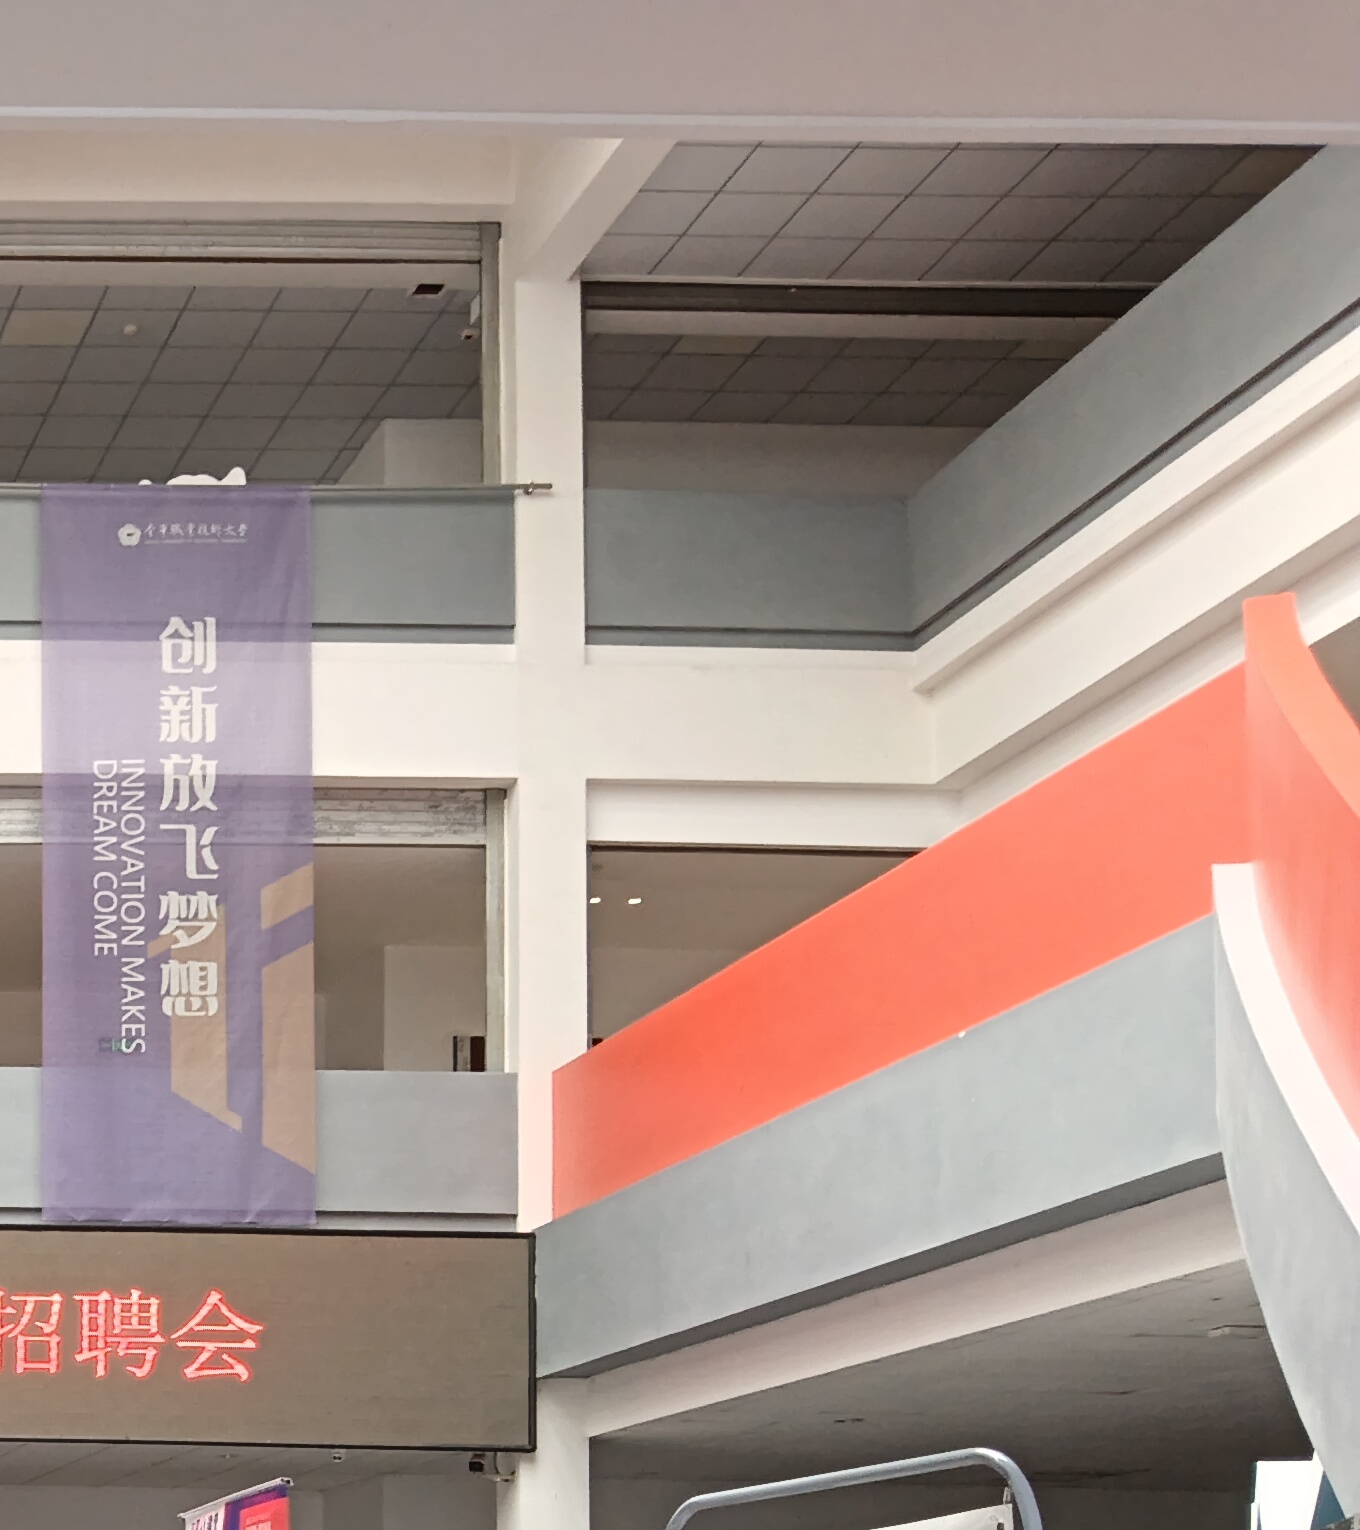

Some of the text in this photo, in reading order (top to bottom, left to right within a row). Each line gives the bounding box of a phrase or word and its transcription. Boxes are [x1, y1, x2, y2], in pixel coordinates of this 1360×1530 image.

[92, 759, 118, 957] DREAM COME
[120, 758, 147, 1054] INNOVATION MAKES
[158, 615, 221, 1018] 创新放飞梦想
